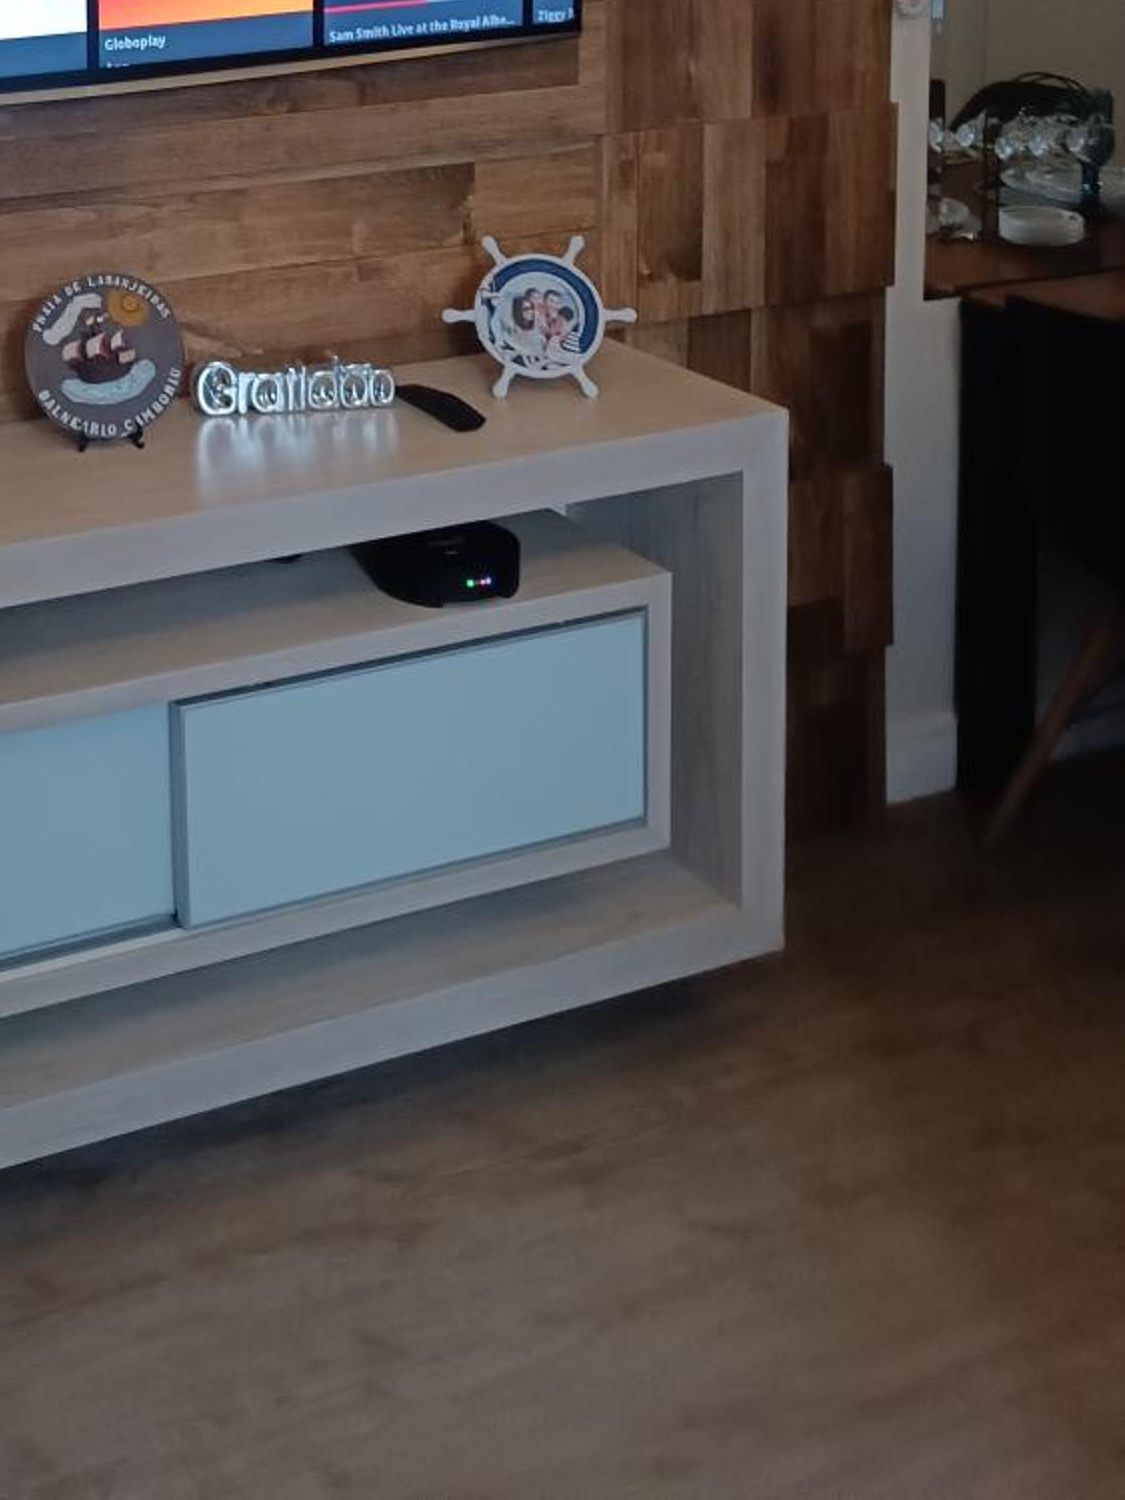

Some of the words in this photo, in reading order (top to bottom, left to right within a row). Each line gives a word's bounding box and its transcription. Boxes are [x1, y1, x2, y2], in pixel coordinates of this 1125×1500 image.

[329, 30, 354, 43] Sam
[356, 24, 390, 40] Smith
[391, 22, 415, 38] Live
[416, 21, 428, 34] at
[429, 20, 448, 34] the
[104, 35, 167, 51] Globoplay
